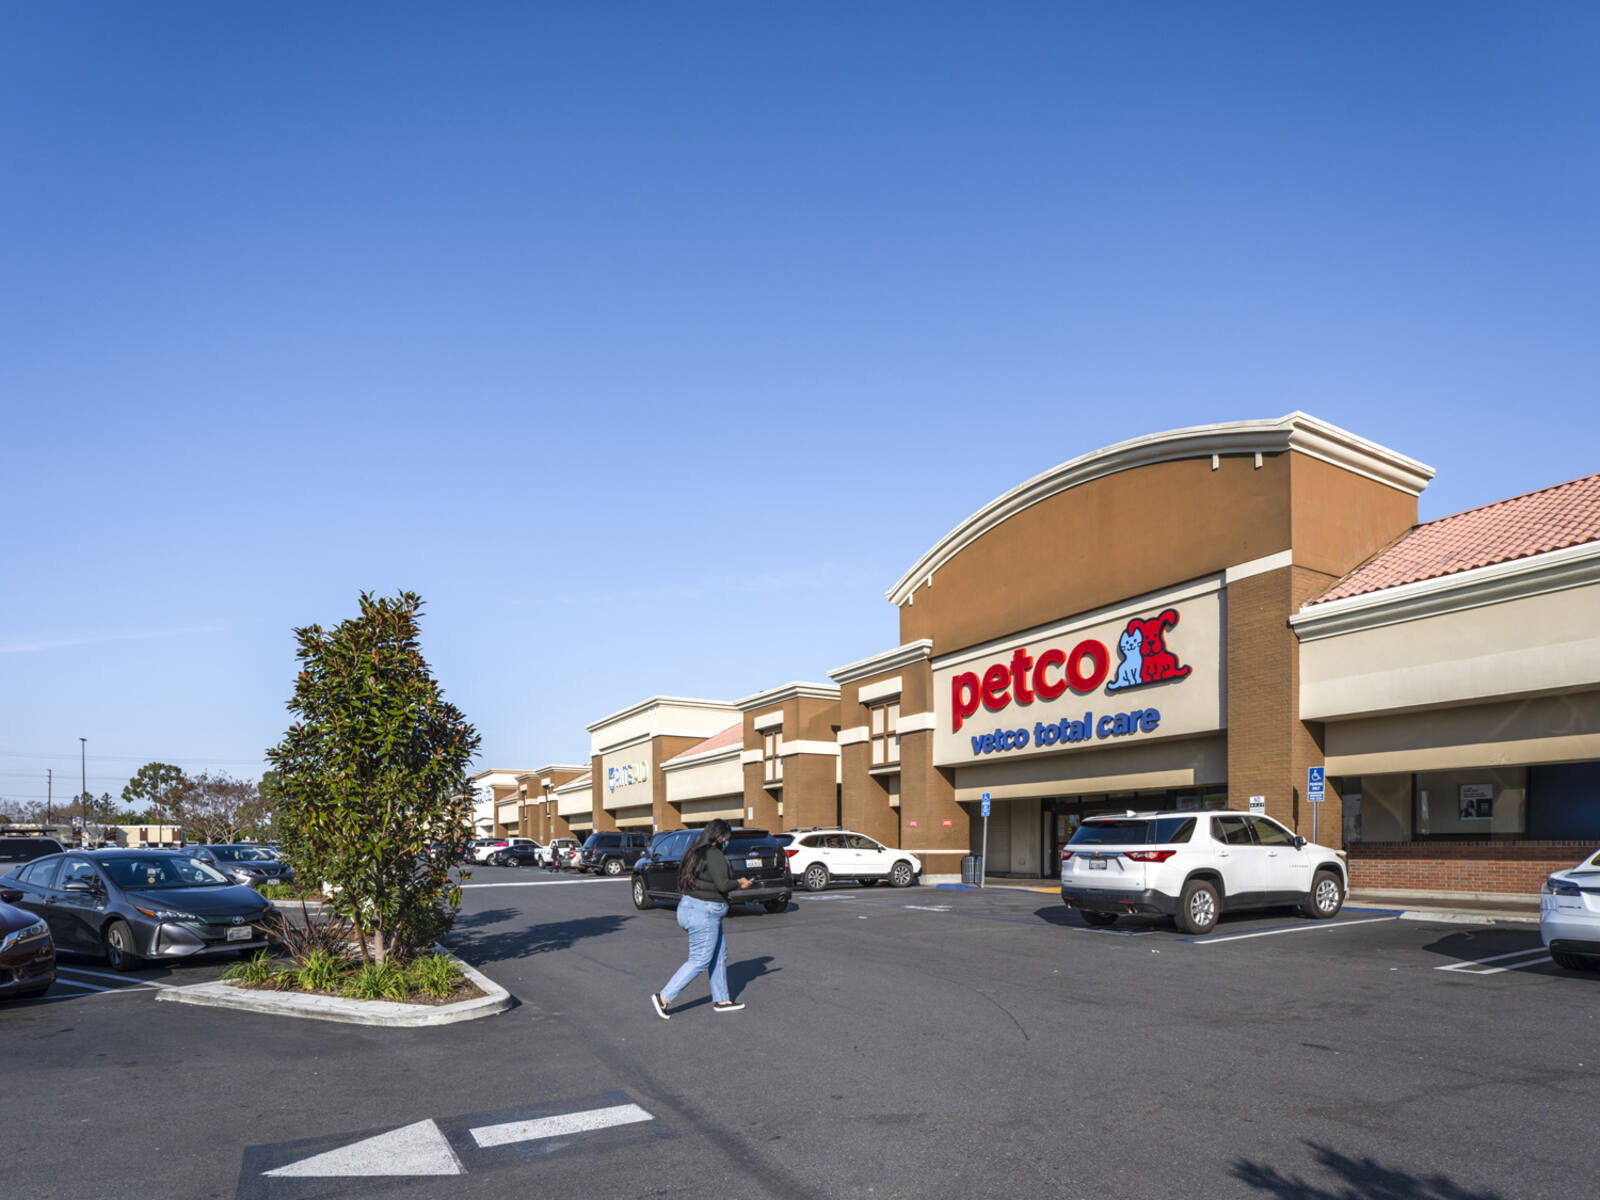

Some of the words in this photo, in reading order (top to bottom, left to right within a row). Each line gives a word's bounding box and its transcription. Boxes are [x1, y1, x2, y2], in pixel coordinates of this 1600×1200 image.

[952, 639, 1110, 731] petco
[971, 728, 1030, 754] vetco
[1034, 712, 1093, 747] total
[1097, 707, 1161, 738] care
